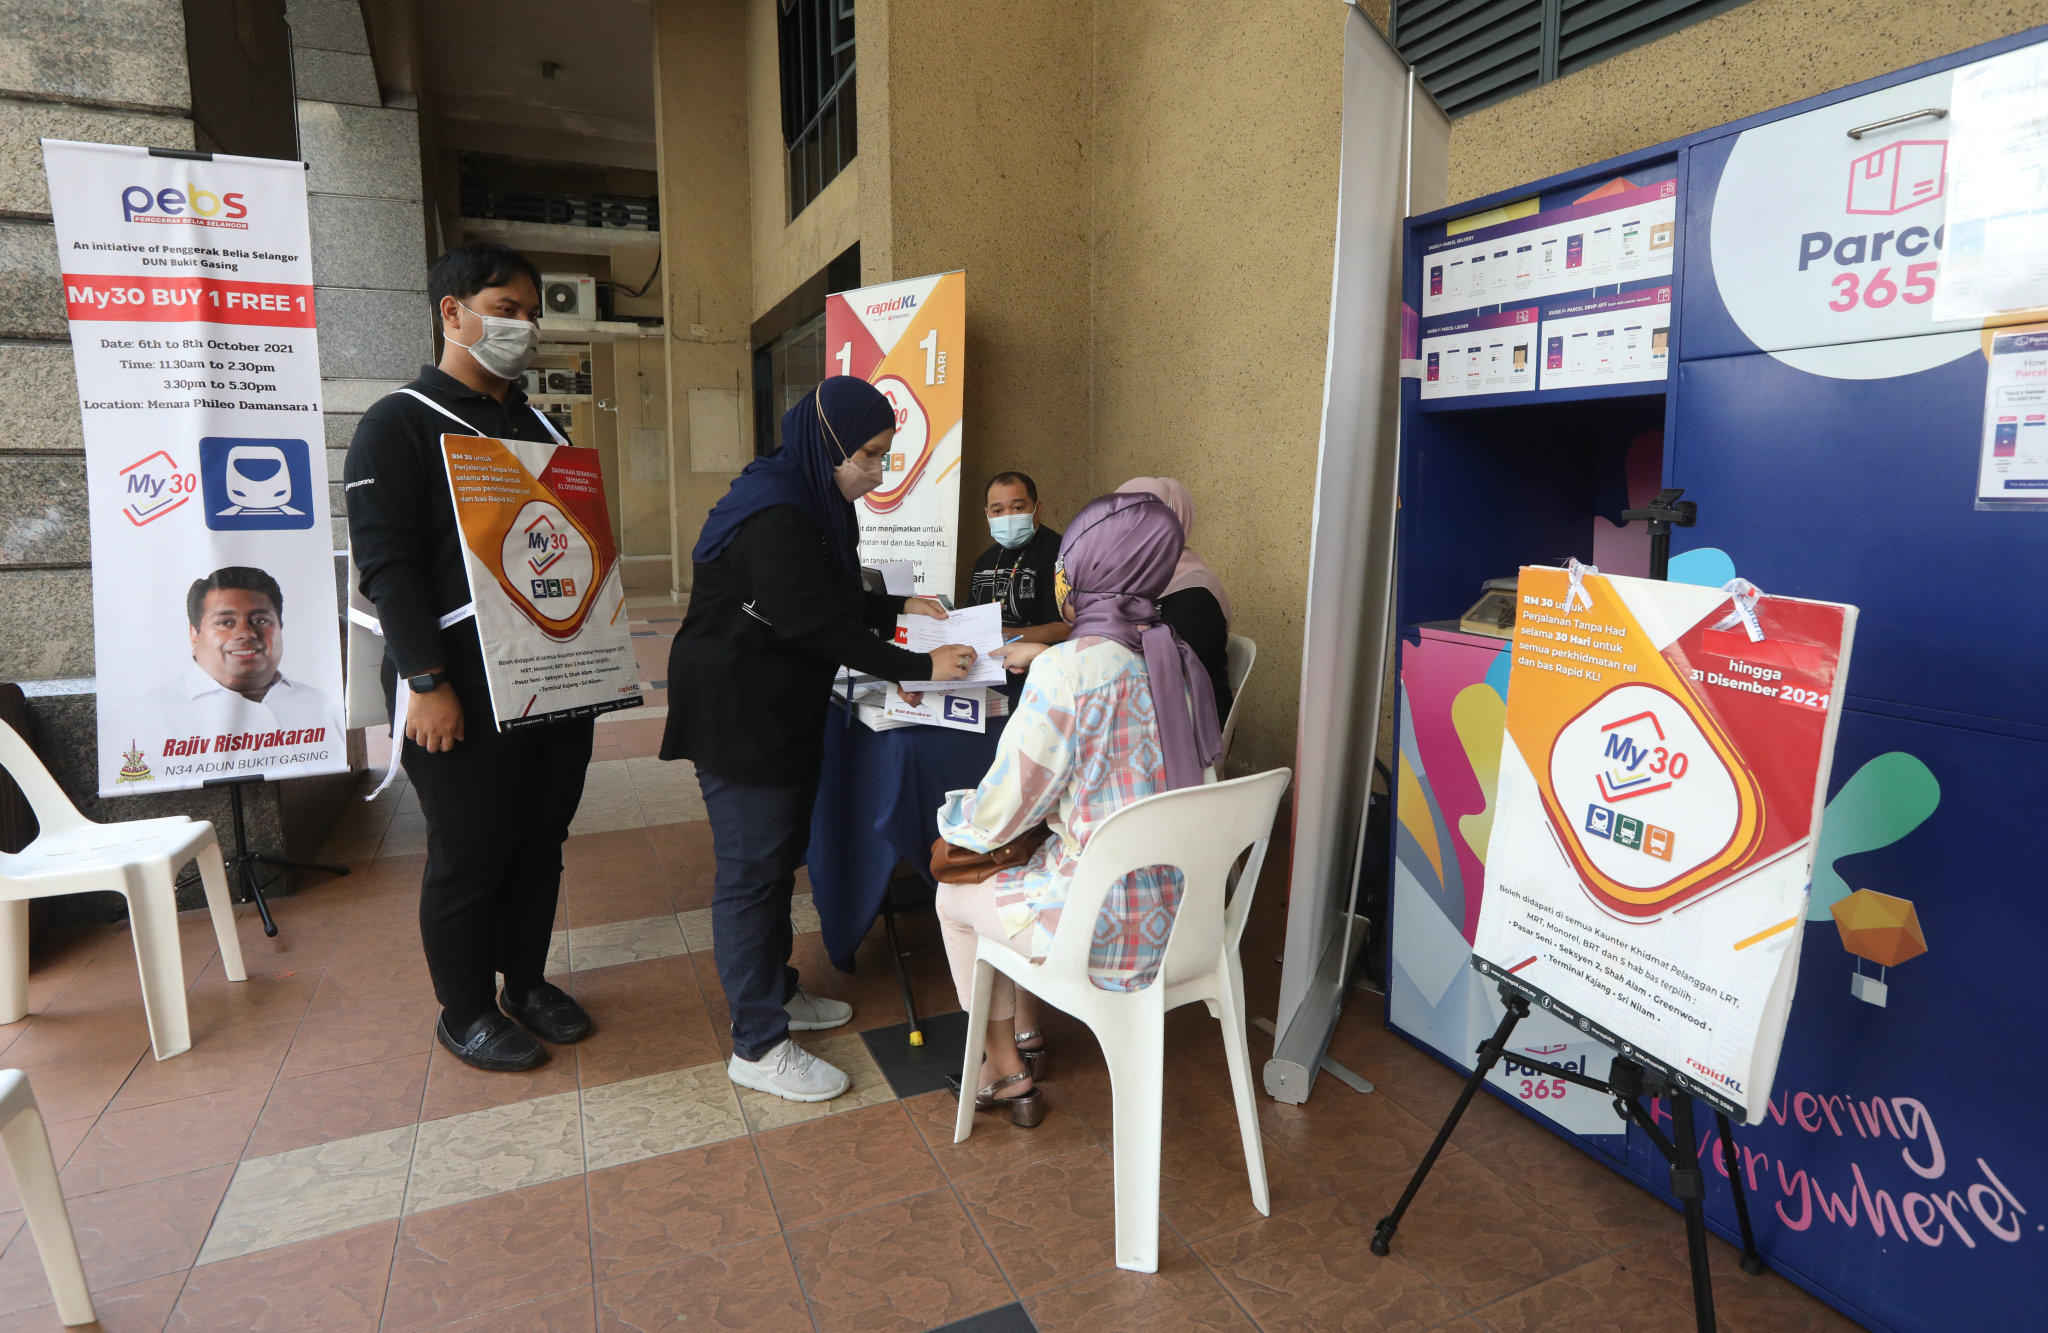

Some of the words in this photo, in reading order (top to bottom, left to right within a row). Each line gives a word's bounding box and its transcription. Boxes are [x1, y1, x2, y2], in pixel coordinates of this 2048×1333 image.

[122, 182, 247, 222] pebs
[206, 221, 247, 229] SELANGOR
[1457, 235, 1474, 244] DELIVERY
[73, 241, 89, 251] An
[92, 242, 145, 253] initiative
[148, 244, 159, 253] of
[162, 245, 219, 257] Penggerak
[222, 249, 249, 259] Belia
[252, 251, 299, 264] Selangor
[142, 257, 167, 266] DUN
[170, 257, 198, 267] Bukit
[200, 259, 238, 272] Gasing
[1828, 261, 1938, 313] 365
[68, 286, 145, 309] My30
[152, 288, 202, 306] BUY
[209, 291, 220, 307] 1
[227, 292, 291, 311] FREE
[296, 296, 306, 313] 1
[866, 294, 917, 316] rapidKL
[1567, 305, 1584, 313] PARCEL
[1585, 302, 1607, 310] DROP-OFF
[100, 339, 134, 349] Date:
[138, 339, 162, 349] 6th
[166, 341, 179, 349] to
[182, 339, 203, 349] 8th
[207, 339, 260, 352] October
[264, 343, 294, 354] 2021
[835, 341, 852, 376] 1
[920, 329, 937, 386] 1
[119, 359, 155, 369] Time:
[209, 361, 223, 370] to
[227, 361, 276, 374] 2.30pm
[937, 351, 947, 385] HARI
[2015, 368, 2048, 378] Parcel
[2024, 359, 2047, 367] How
[163, 379, 206, 391] 3.30pm
[210, 380, 225, 389] to
[229, 380, 277, 393] 5.30pm
[84, 400, 144, 409] Location:
[147, 400, 190, 409] Menara
[193, 399, 235, 410] Phileo
[238, 401, 308, 411] Damansara
[311, 403, 318, 411] 1
[878, 524, 921, 533] menjimatkan
[922, 525, 943, 533] untuk
[916, 540, 934, 548] Rapid
[913, 572, 925, 583] ari
[1523, 595, 1539, 605] RM
[1541, 598, 1553, 608] 30
[1555, 601, 1584, 613] unuk
[1523, 611, 1571, 627] Perjalanan
[1574, 619, 1602, 633] Tanpa
[1605, 625, 1626, 637] Had
[1521, 626, 1553, 639] selama
[1555, 631, 1568, 642] 30
[1570, 635, 1591, 647] Hari
[1593, 640, 1623, 653] untuk
[1518, 656, 1535, 667] dan
[1537, 660, 1553, 671] bas
[1555, 664, 1583, 678] Rapid
[1585, 670, 1601, 681] KL!
[1519, 642, 1549, 655] semua
[1551, 648, 1620, 670] perkhidmatan
[1623, 662, 1637, 672] rel
[1728, 659, 1782, 681] hingga
[1690, 668, 1704, 681] 31
[1707, 672, 1779, 698] Disember
[1780, 685, 1830, 709] 2021
[163, 736, 210, 757] Rajiv
[214, 727, 325, 753] Rishyakaran
[165, 764, 193, 776] N34
[196, 761, 234, 773] ADUN
[238, 756, 277, 769] BUKIT
[280, 751, 328, 764] GASING
[1499, 884, 1521, 899] Boleh
[1522, 895, 1554, 915] didapati
[1556, 911, 1564, 919] di
[1565, 915, 1593, 933] semua
[1594, 928, 1629, 949] Kaunter
[1630, 945, 1669, 970] Khidmat
[1670, 965, 1718, 995] Pelanggan
[1719, 991, 1740, 1009] LRT,
[1526, 912, 1545, 927] MRT,
[1546, 922, 1581, 944] Monorel,
[1582, 940, 1601, 952] BRT
[1601, 948, 1618, 962] dan
[1620, 957, 1625, 965] 5
[1627, 960, 1643, 975] hab
[1645, 968, 1659, 983] bas
[1660, 979, 1692, 1003] terpilih
[1513, 921, 1533, 936] Pasar
[1535, 932, 1552, 946] Seni
[1559, 943, 1593, 968] Seksyen
[1595, 962, 1602, 973] 2,
[1604, 966, 1624, 983] Shah
[1625, 980, 1647, 996] Alam
[1653, 995, 1707, 1029] Greenwood
[1549, 954, 1584, 978] Terminal
[1585, 974, 1612, 996] Kajang
[1617, 993, 1629, 1005] Sri
[1630, 1000, 1655, 1020] Nilam
[1686, 1057, 1744, 1094] rapidKL
[1519, 1079, 1567, 1099] 365
